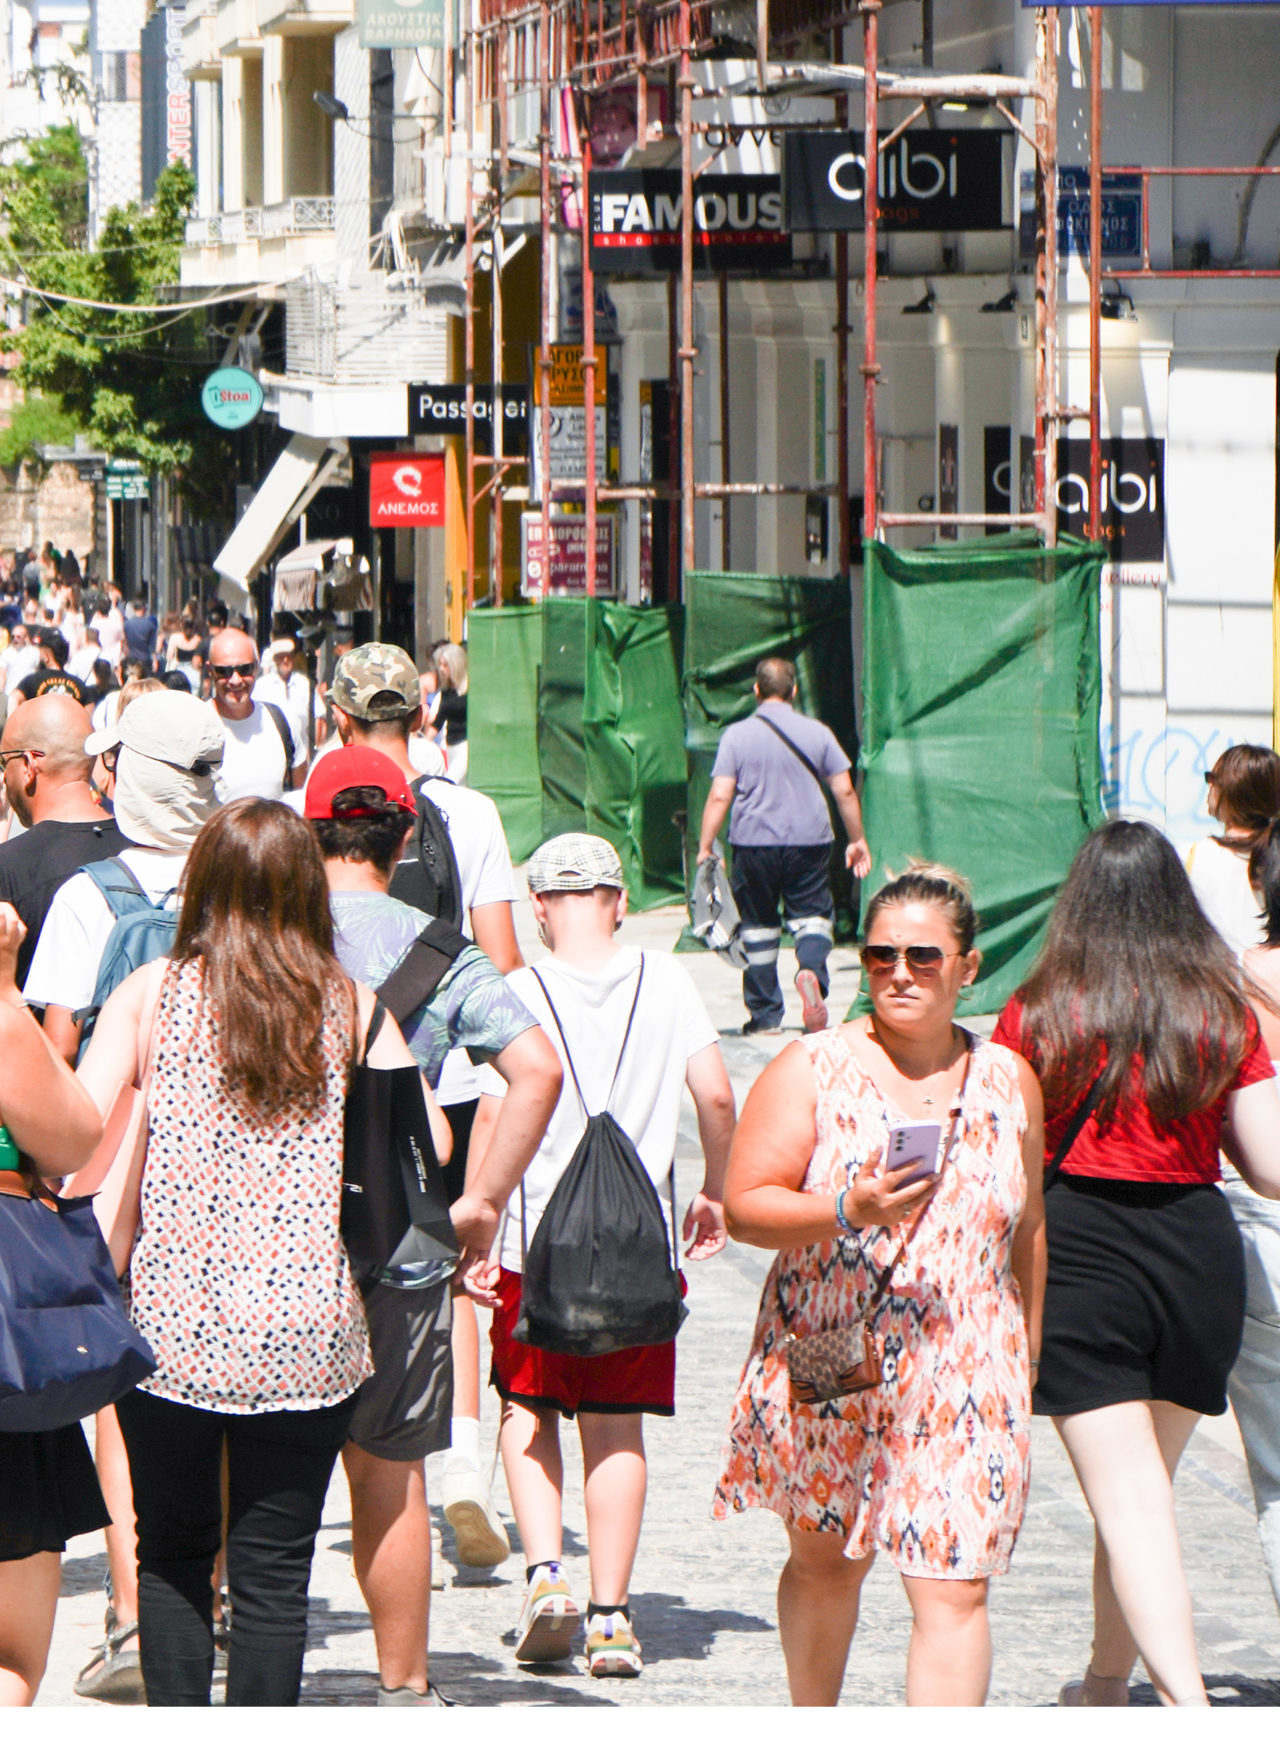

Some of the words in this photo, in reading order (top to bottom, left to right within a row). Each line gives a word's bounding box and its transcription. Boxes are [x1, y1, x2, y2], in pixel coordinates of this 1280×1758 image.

[827, 136, 958, 200] alibi
[601, 193, 782, 232] FAMOUS
[377, 503, 439, 516] ΑΝΕΜΟΣ
[1054, 459, 1157, 514] aibi
